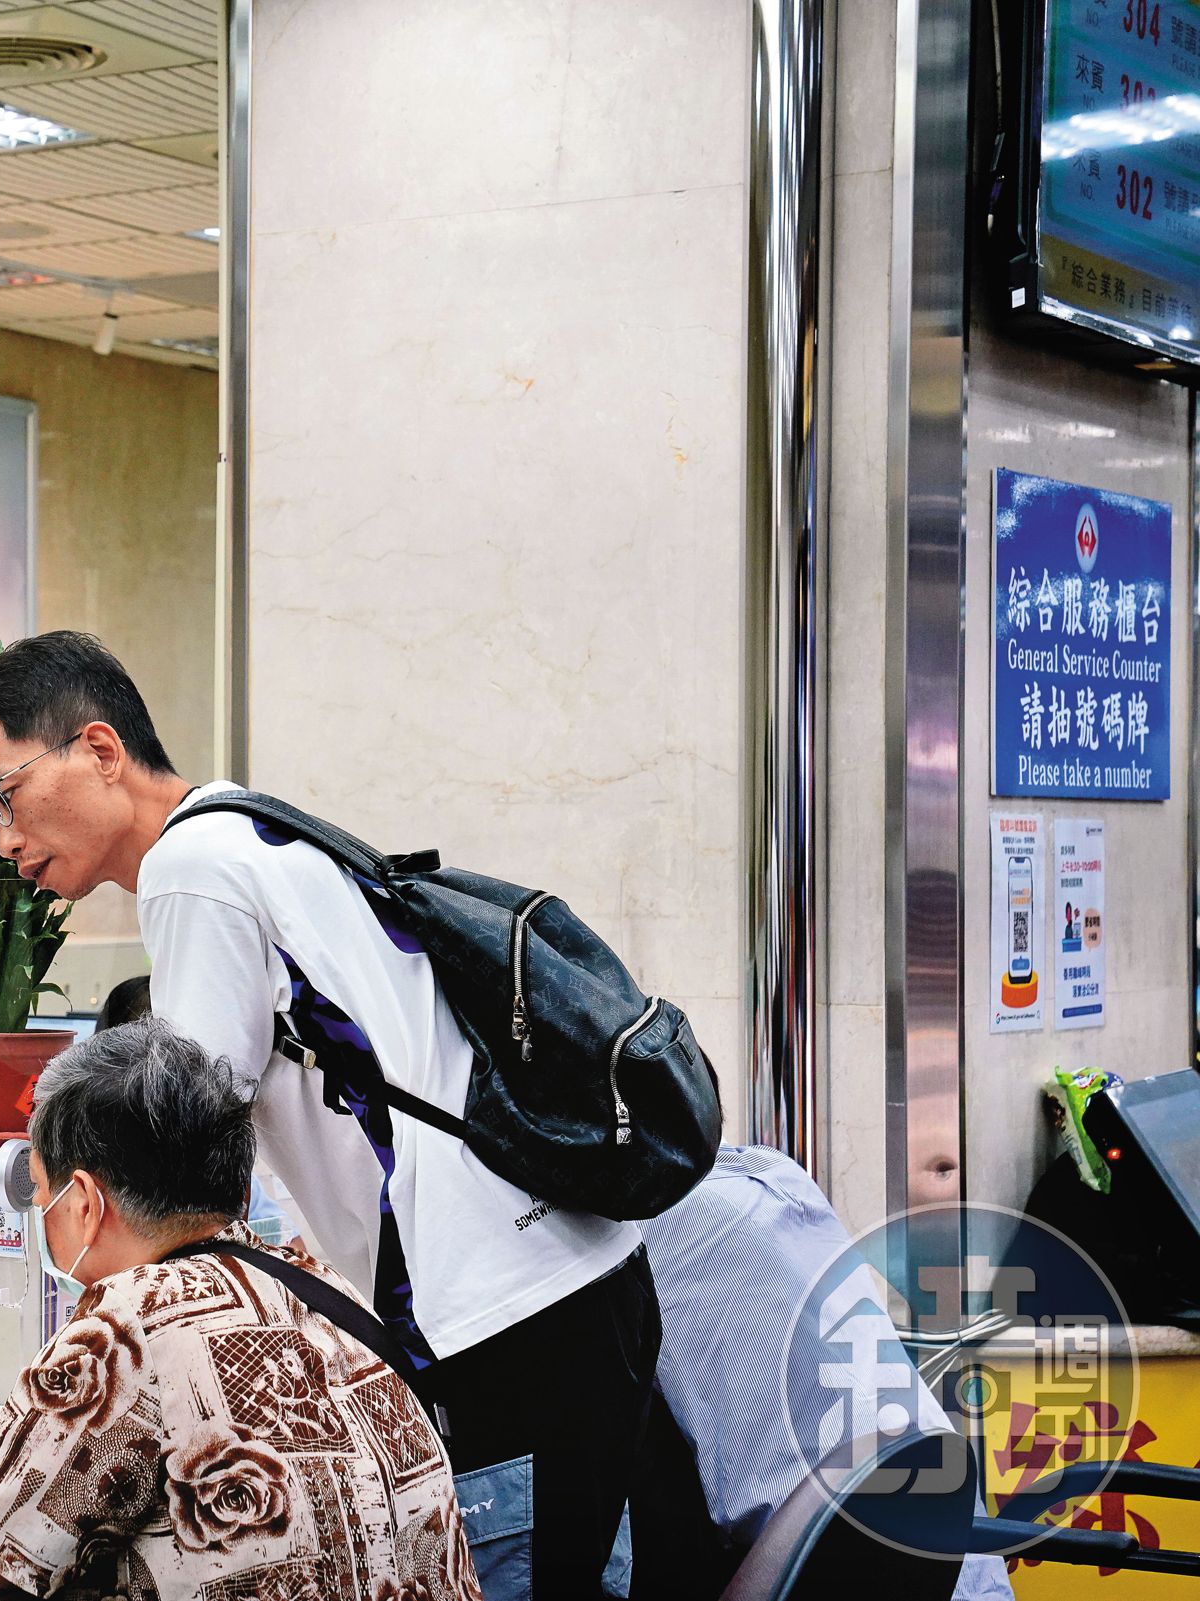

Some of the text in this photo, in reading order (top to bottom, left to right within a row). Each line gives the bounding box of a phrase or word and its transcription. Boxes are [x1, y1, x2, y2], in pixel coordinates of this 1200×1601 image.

[1116, 164, 1154, 221] 302
[1007, 566, 1161, 646] 綜合服務櫃台
[1007, 638, 1162, 683] General Service Counter
[1020, 681, 1150, 755] 請抽號碼牌
[1018, 754, 1152, 789] Please take a number
[514, 1202, 559, 1231] SOMEWH
